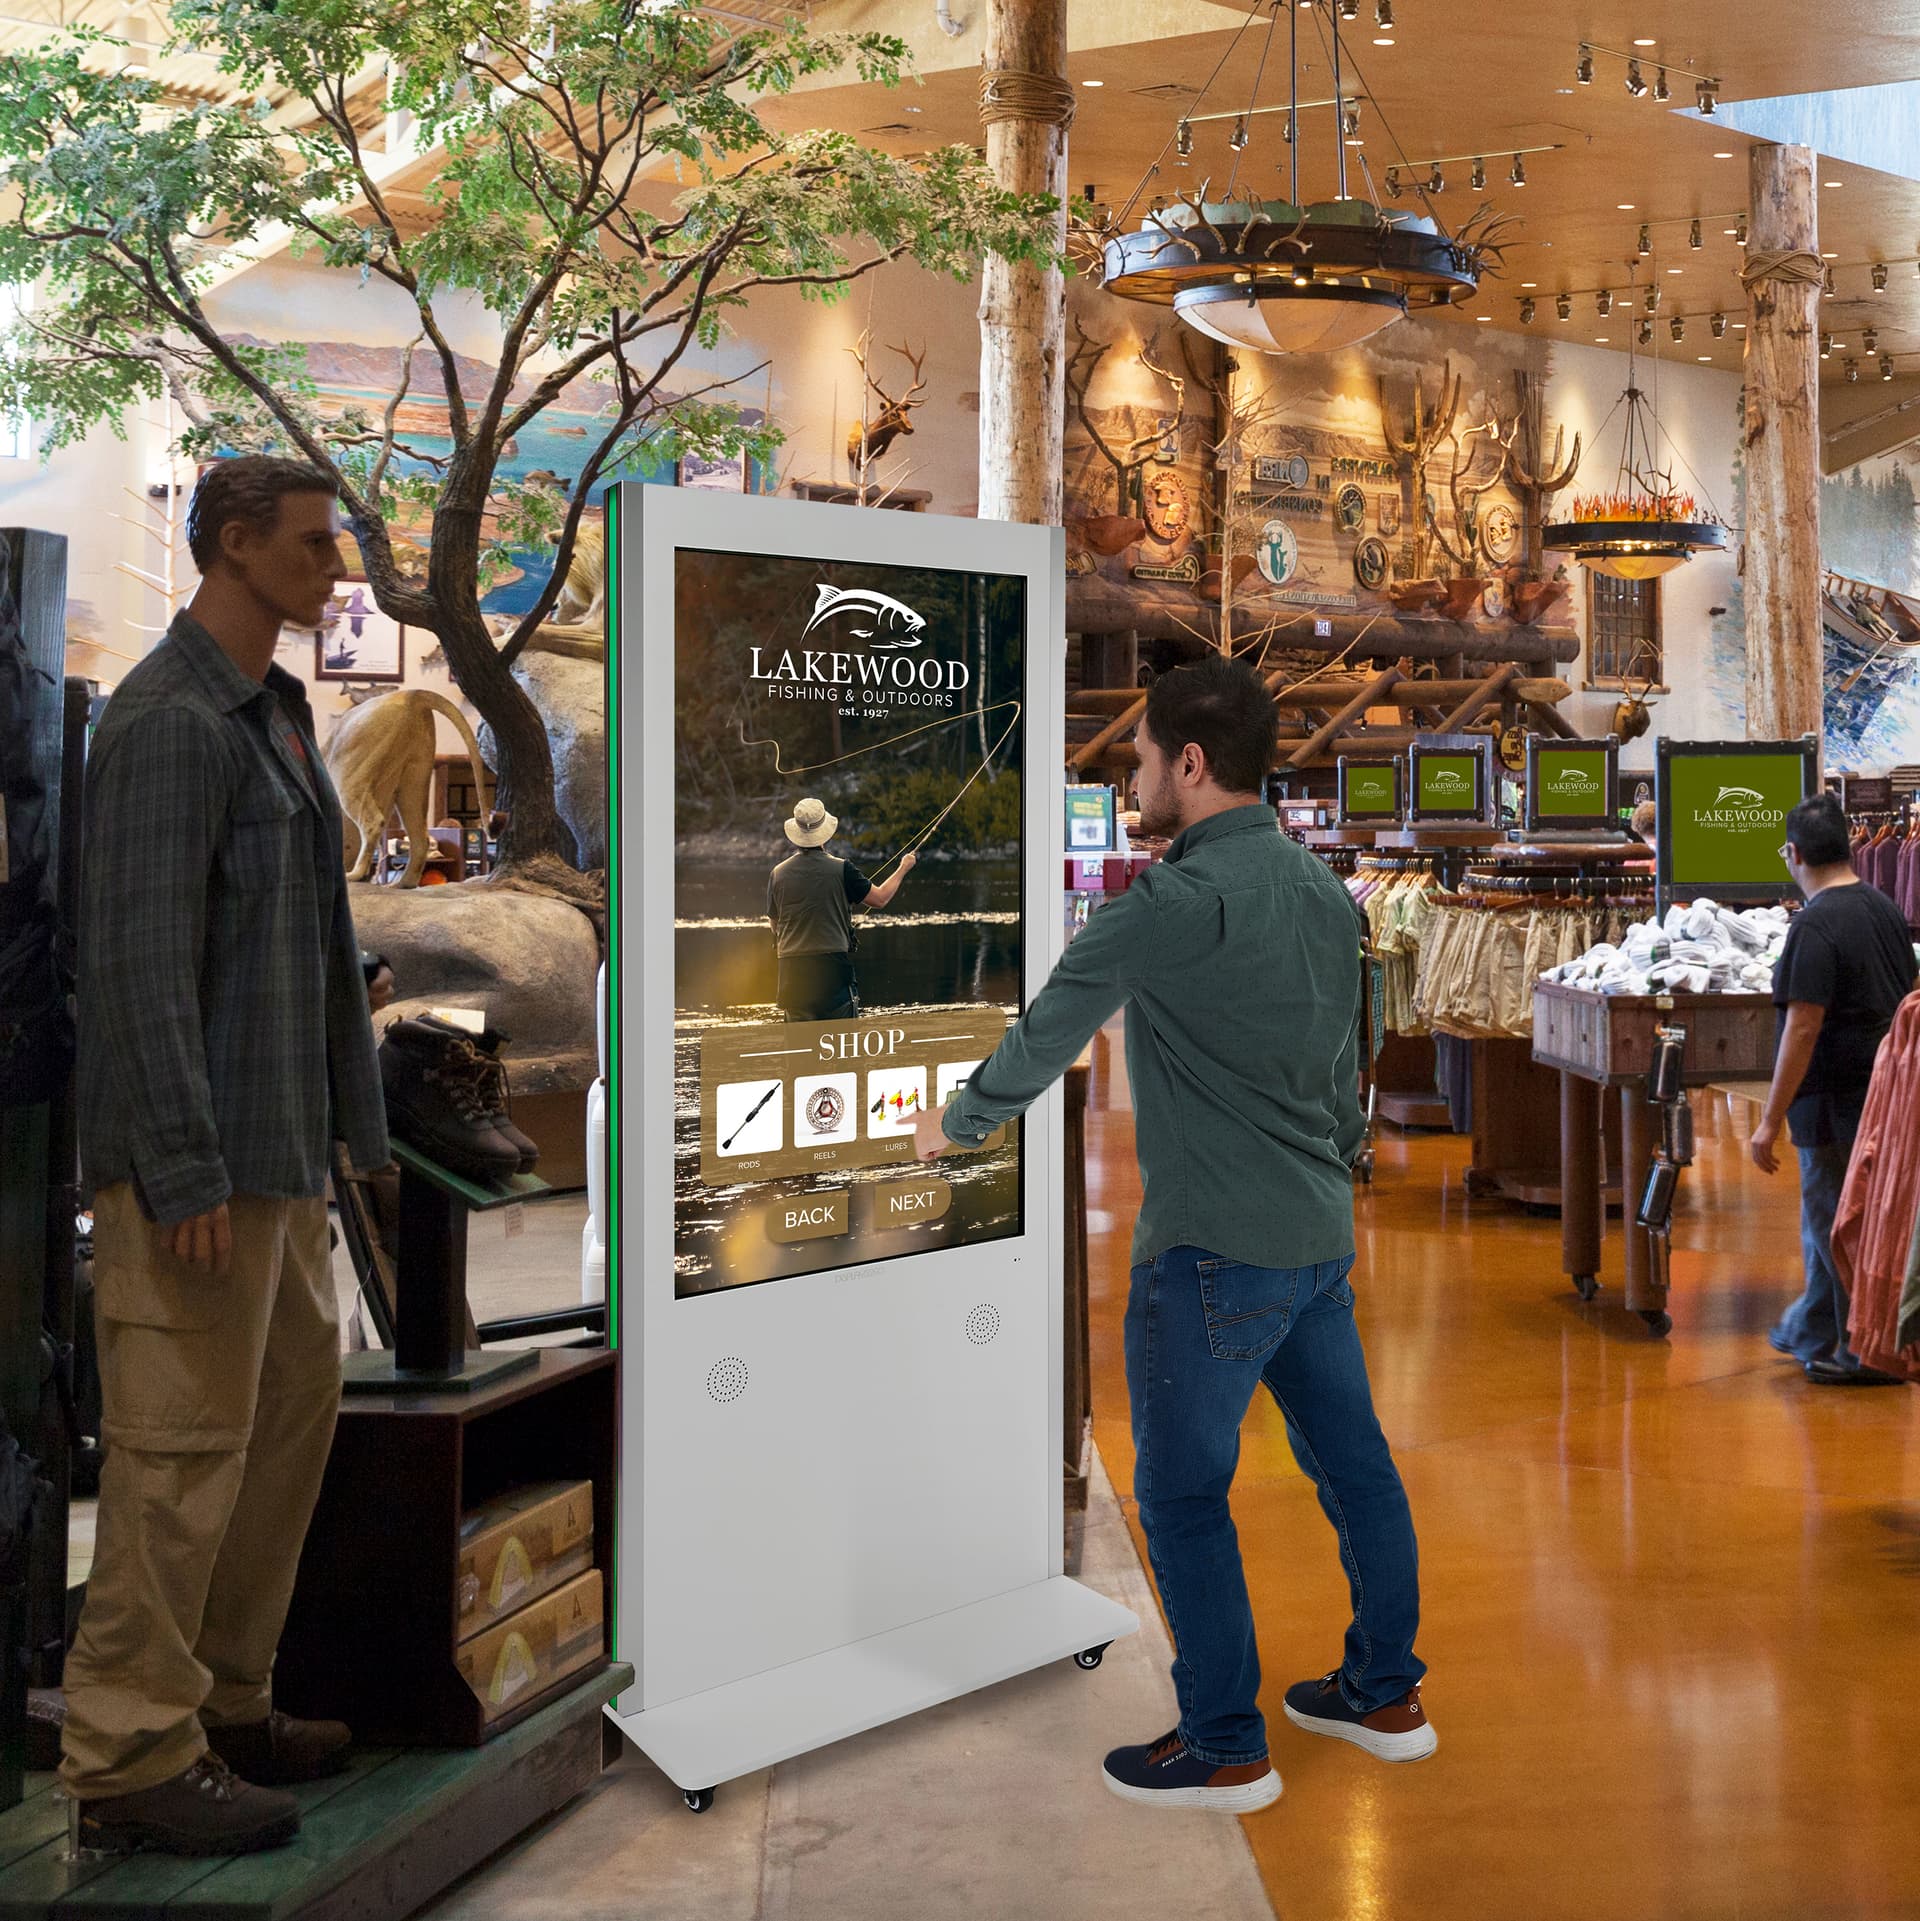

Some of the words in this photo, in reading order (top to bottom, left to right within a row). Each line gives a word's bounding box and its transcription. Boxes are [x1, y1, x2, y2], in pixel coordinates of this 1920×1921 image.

[749, 646, 970, 690] LAKEWOOD
[768, 684, 838, 701] FISHING
[845, 689, 855, 702] &
[862, 689, 953, 707] OUTDOORS
[838, 707, 859, 717] est.
[863, 708, 889, 719] 1927
[1547, 782, 1599, 790] LAKEWOOD
[1693, 809, 1784, 822] LAKEWOOD
[818, 1028, 905, 1061] SHOP
[885, 1141, 908, 1152] LURES
[813, 1150, 837, 1161] REELS
[738, 1160, 761, 1170] RODS
[889, 1191, 937, 1213] NEXT
[784, 1206, 836, 1228] BACK
